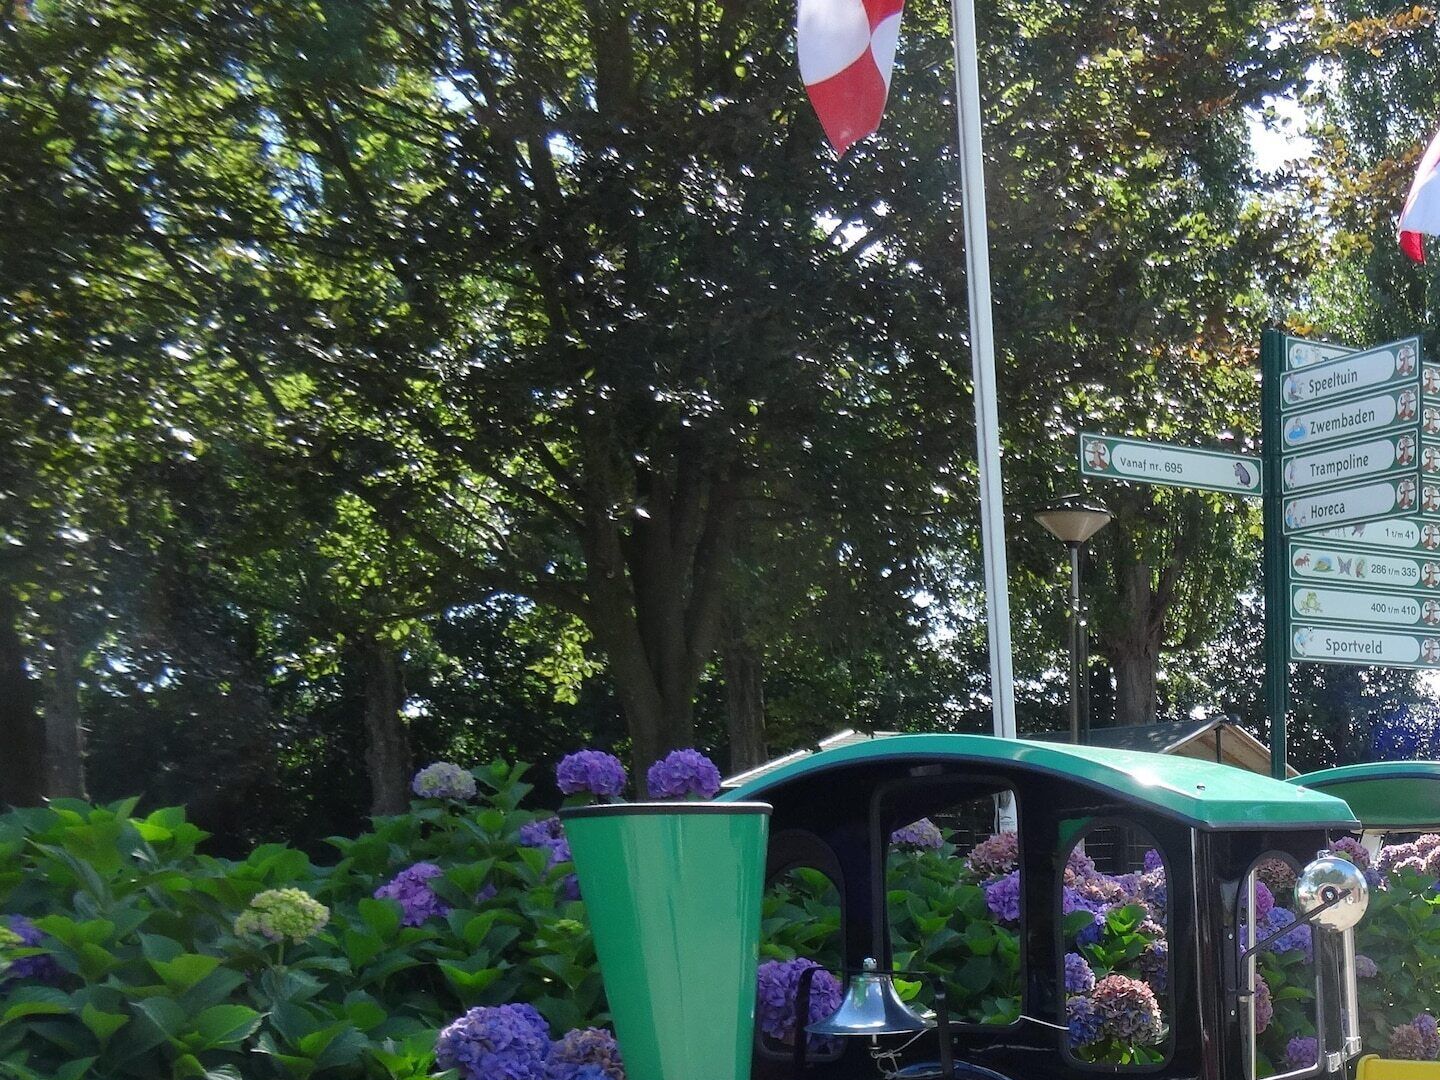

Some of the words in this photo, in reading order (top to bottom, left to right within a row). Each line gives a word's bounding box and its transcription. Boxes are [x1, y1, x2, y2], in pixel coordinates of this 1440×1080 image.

[1308, 369, 1358, 397] Speeltuin
[1310, 409, 1375, 435] Zwembaden
[1120, 457, 1147, 471] Vanaf
[1149, 463, 1162, 472] nr.
[1164, 462, 1183, 474] 695
[1309, 454, 1369, 477] Trampoline
[1310, 502, 1345, 519] Horeca
[1391, 530, 1403, 539] t/m
[1405, 530, 1414, 540] 41
[1371, 564, 1387, 574] 286
[1388, 567, 1400, 576] t/m
[1401, 567, 1417, 577] 335
[1371, 603, 1386, 613] 400
[1388, 607, 1400, 615] t/m
[1401, 605, 1416, 615] 410
[1325, 638, 1383, 654] Sportveld
